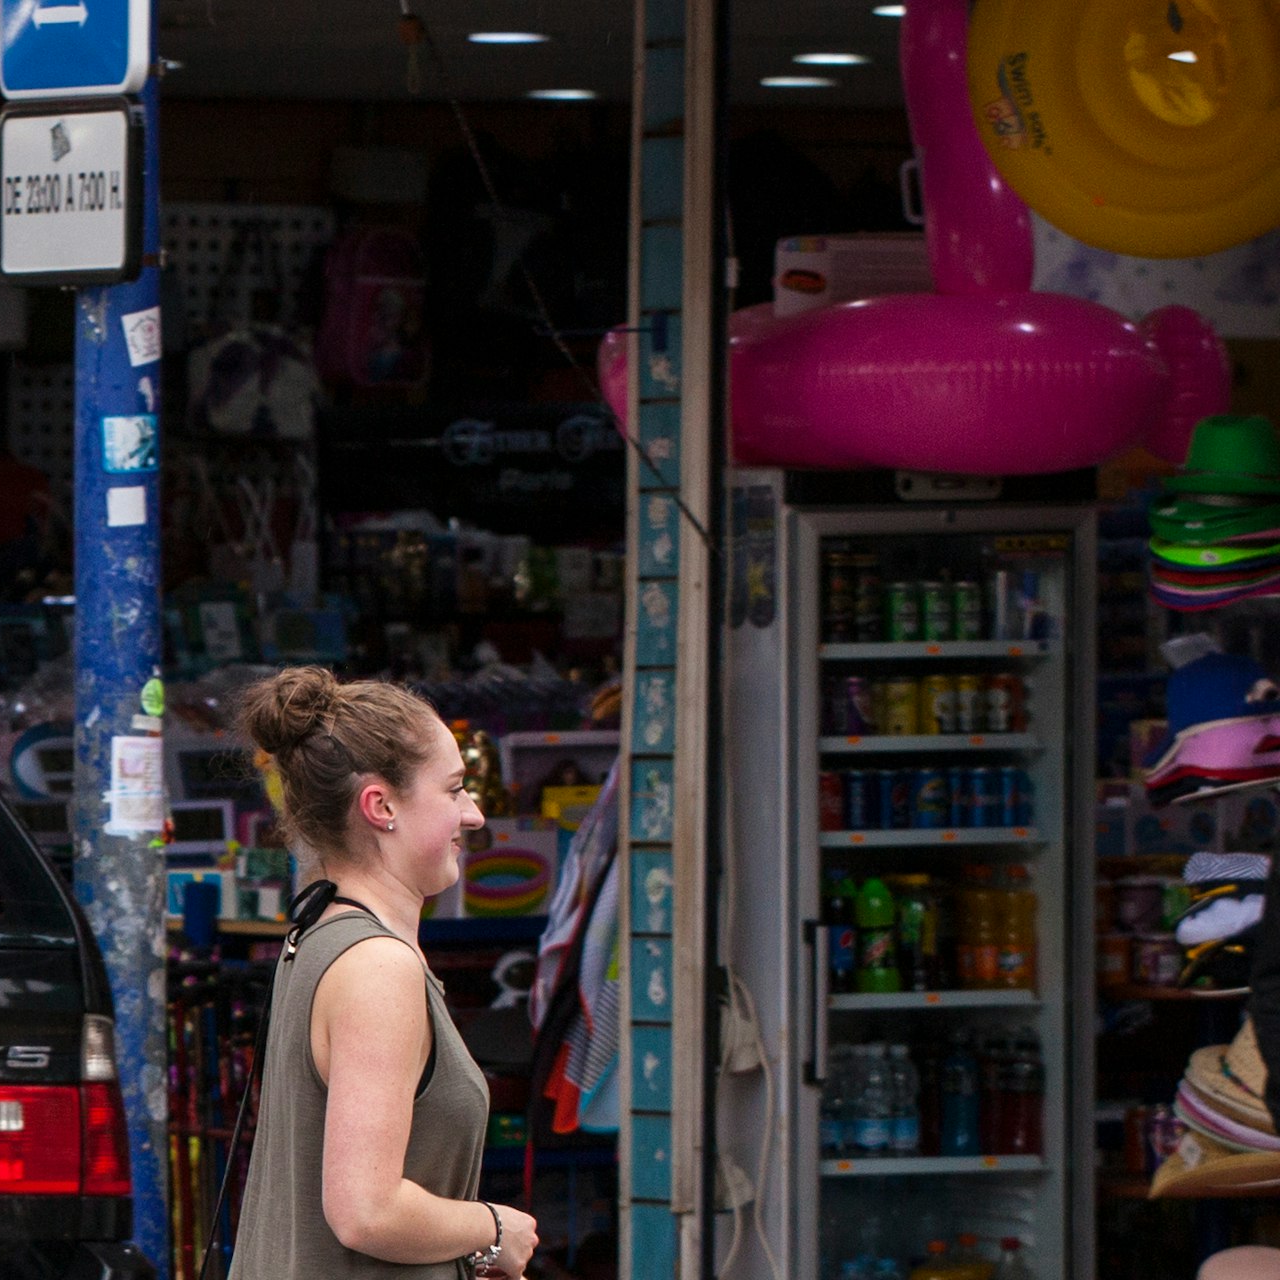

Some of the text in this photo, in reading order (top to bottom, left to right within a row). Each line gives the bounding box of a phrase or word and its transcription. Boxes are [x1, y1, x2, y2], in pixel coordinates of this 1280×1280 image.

[5, 176, 22, 214] DE
[26, 174, 61, 213] 23:00
[65, 173, 75, 212] A
[78, 171, 106, 211] 7:00
